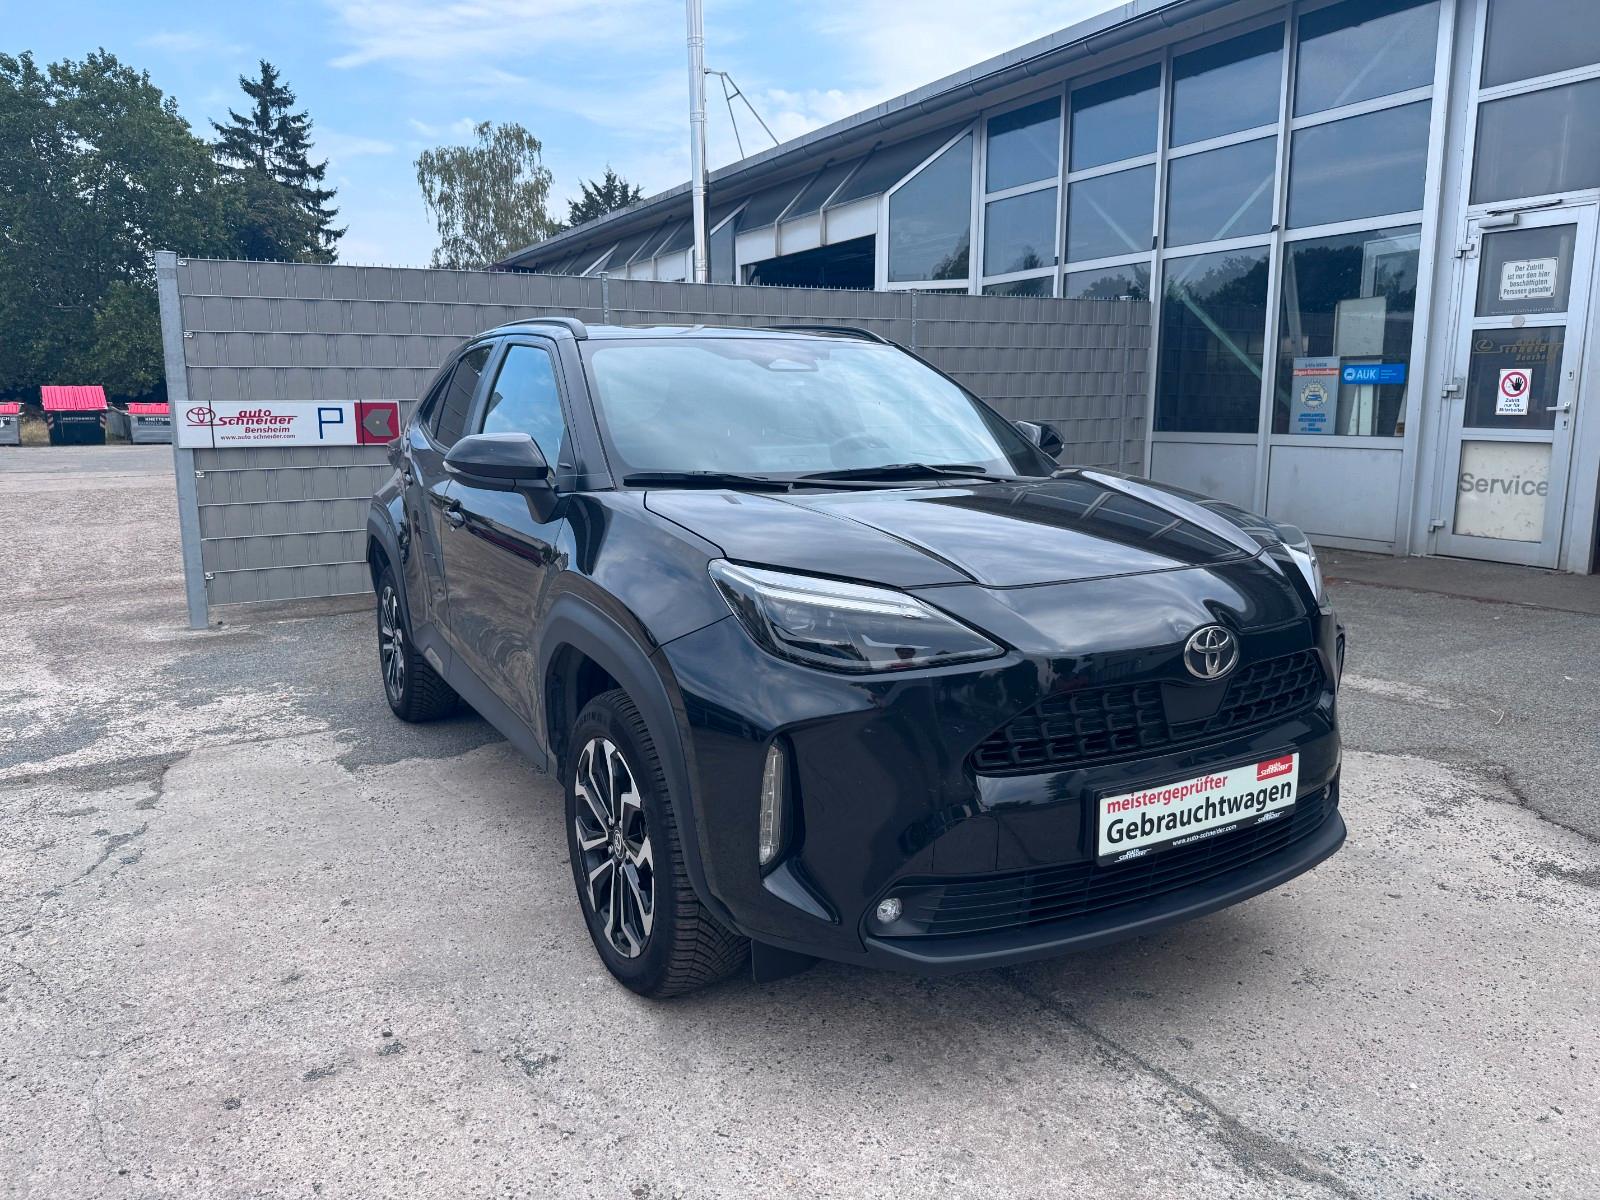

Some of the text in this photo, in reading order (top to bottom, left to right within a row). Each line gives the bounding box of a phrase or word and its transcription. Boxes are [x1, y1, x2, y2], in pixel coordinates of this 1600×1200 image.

[1526, 263, 1544, 271] Zutritt
[1356, 369, 1377, 380] AUK
[239, 408, 272, 417] auto
[219, 416, 294, 426] Schneider
[317, 407, 343, 440] P
[244, 426, 290, 434] Bensheim
[1459, 472, 1549, 497] Service
[1106, 774, 1229, 814] meistergeprüfter
[1106, 781, 1292, 844] Gebrauchtwagen
